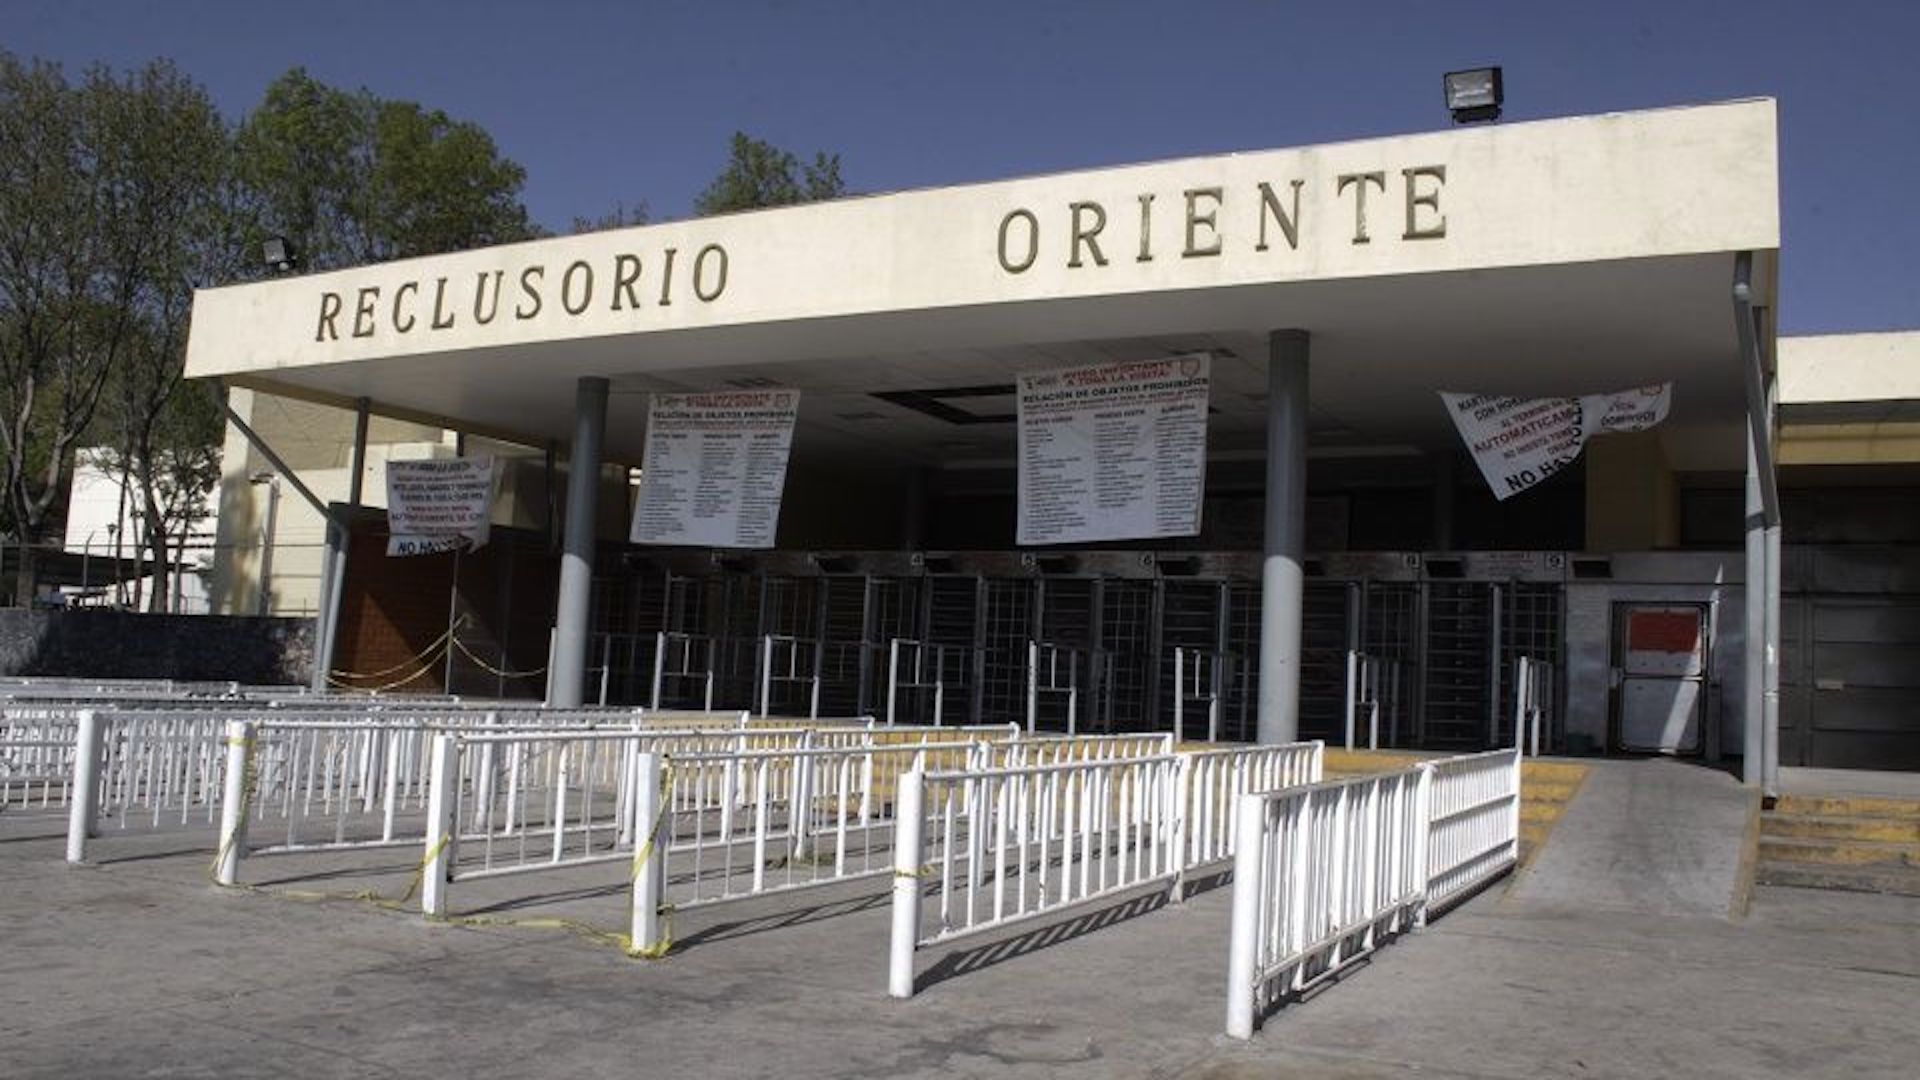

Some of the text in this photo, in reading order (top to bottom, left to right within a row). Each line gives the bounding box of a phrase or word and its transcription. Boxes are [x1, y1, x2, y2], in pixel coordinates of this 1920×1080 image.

[316, 164, 1447, 343] RECLUSORIO ORIENTE
[1505, 470, 1536, 490] NO
